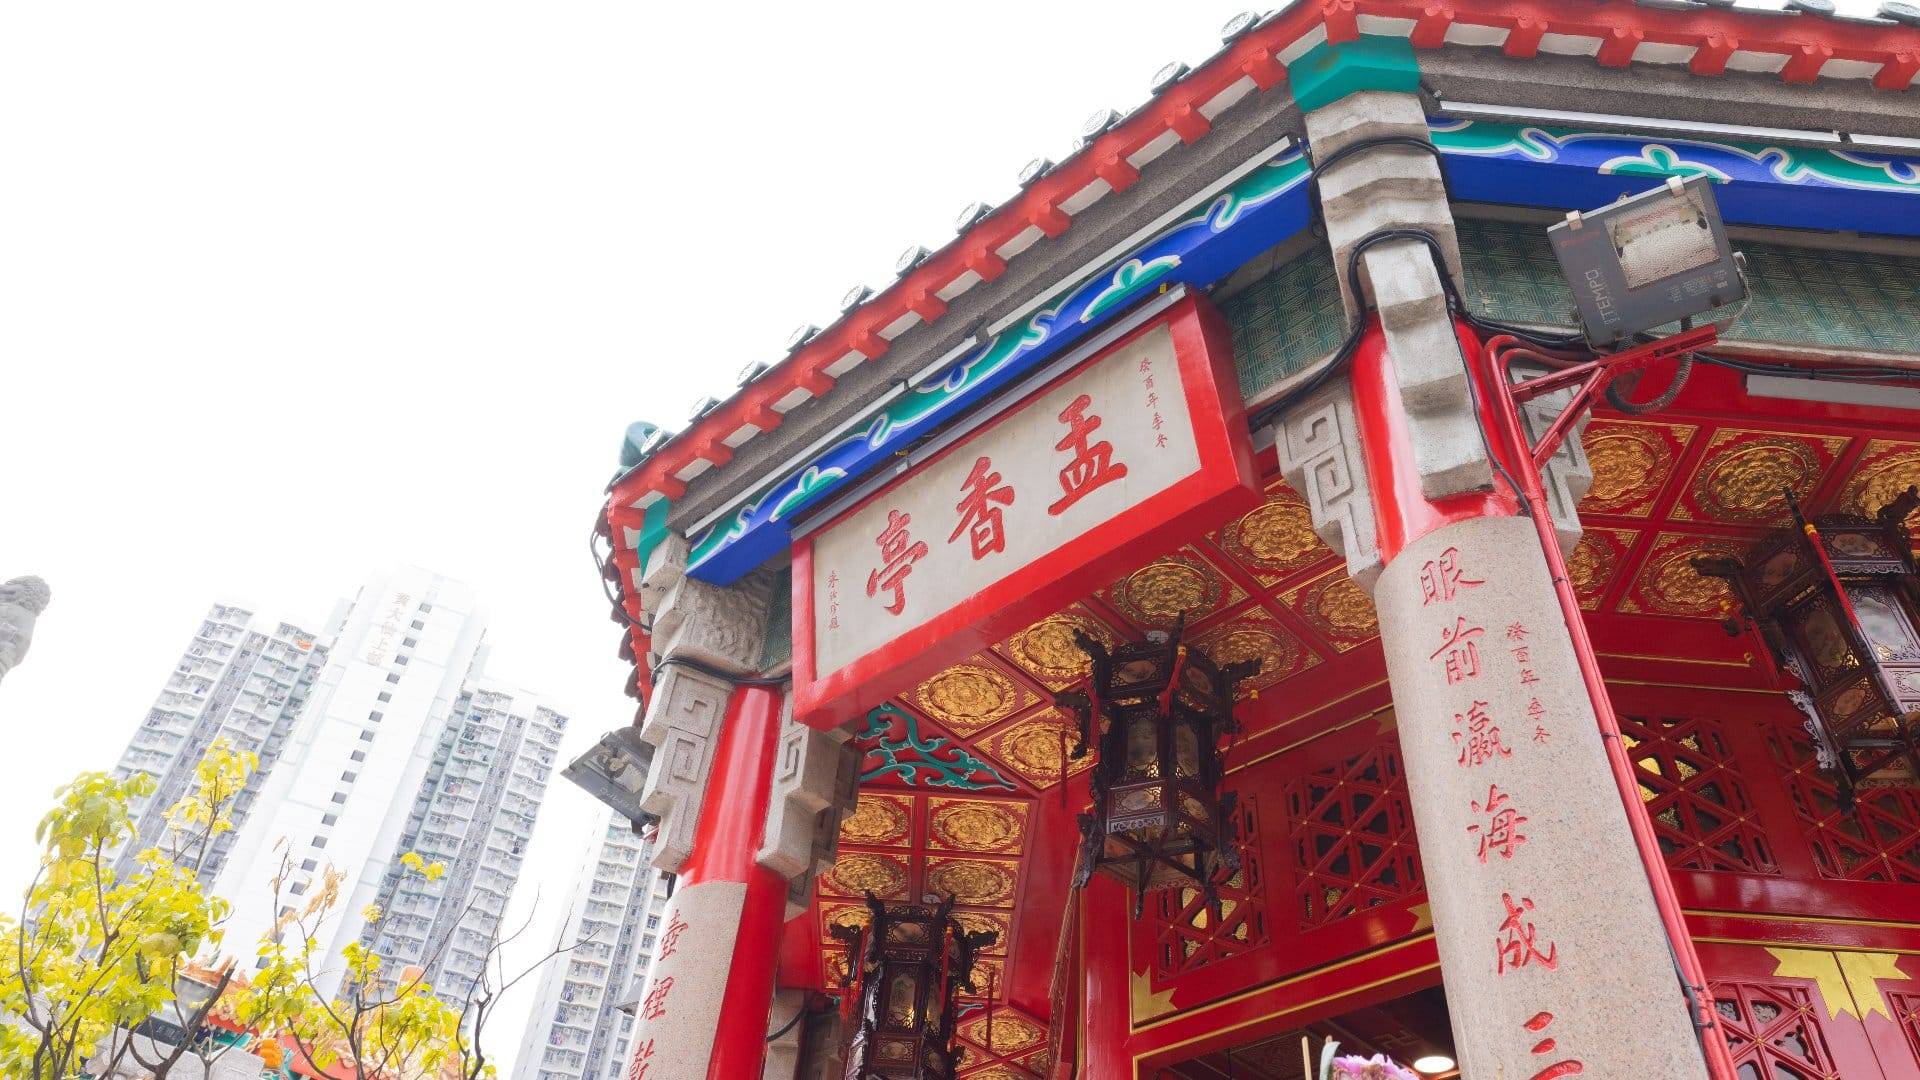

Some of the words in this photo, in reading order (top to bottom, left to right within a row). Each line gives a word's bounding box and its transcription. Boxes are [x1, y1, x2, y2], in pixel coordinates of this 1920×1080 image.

[1586, 268, 1616, 325] TEMPO
[866, 394, 1128, 615] 盂香亭
